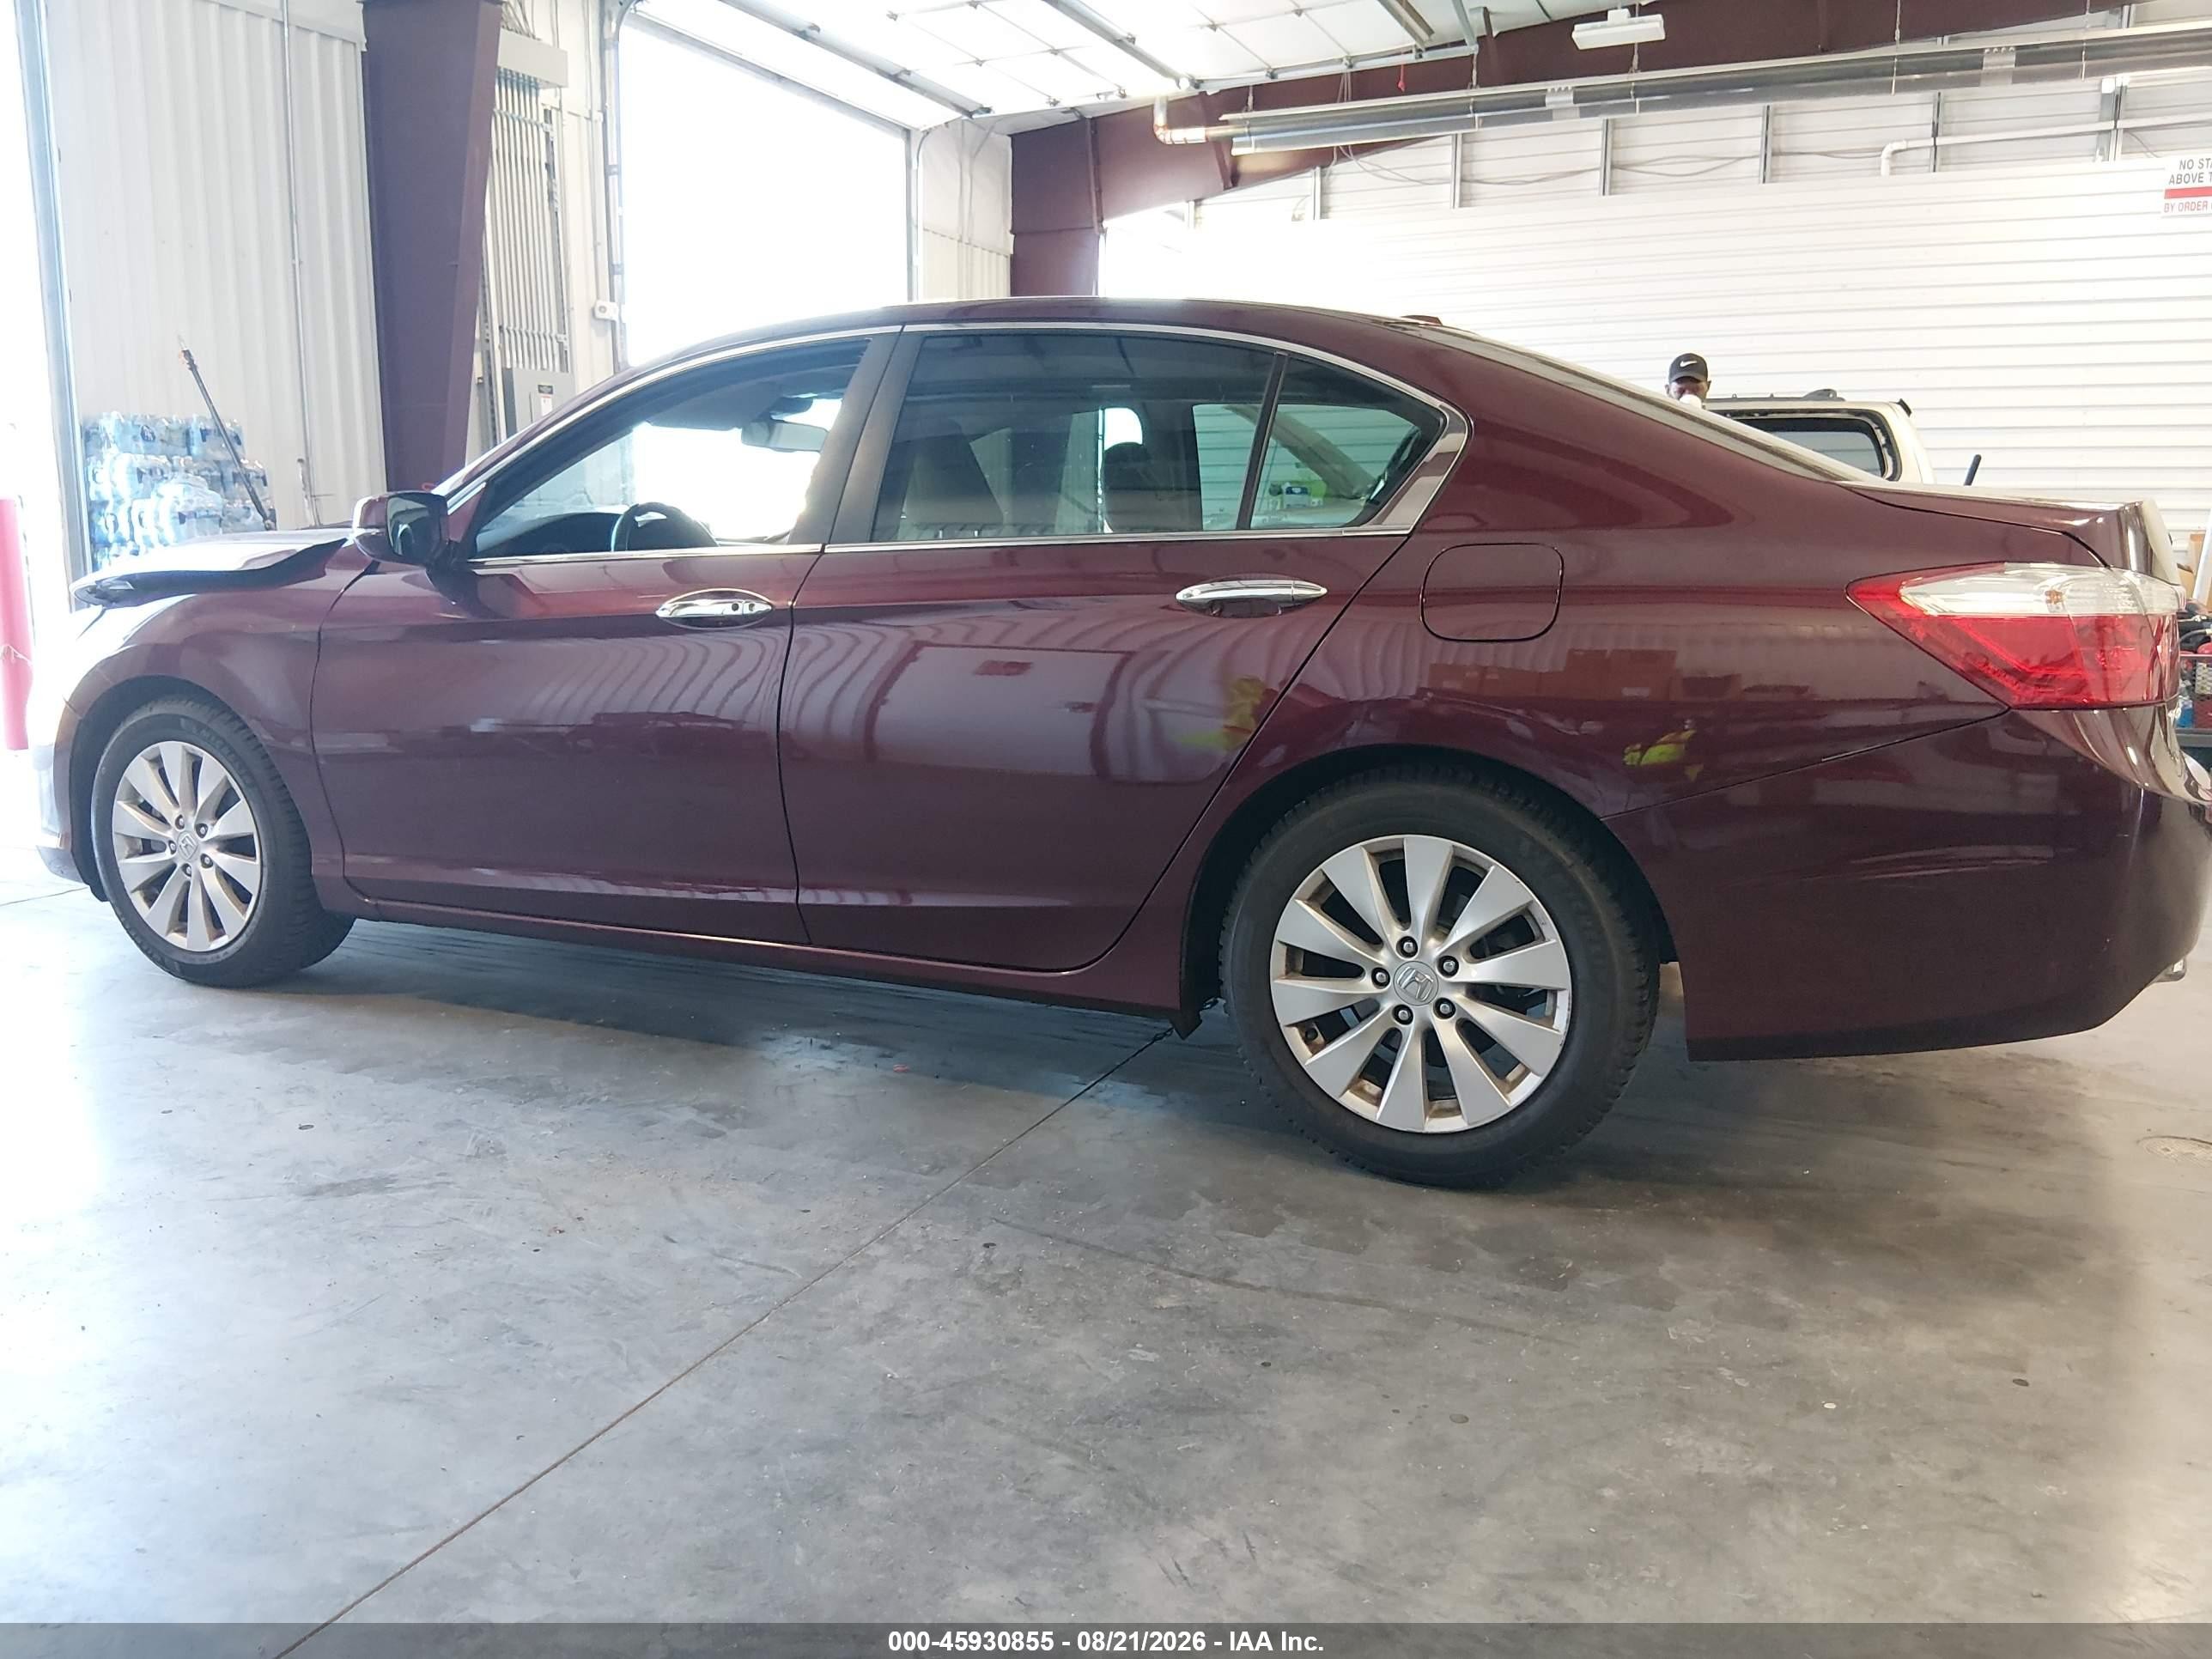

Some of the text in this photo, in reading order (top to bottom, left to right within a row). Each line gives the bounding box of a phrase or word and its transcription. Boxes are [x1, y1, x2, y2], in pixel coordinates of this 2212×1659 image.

[2179, 159, 2195, 170] NO
[2168, 172, 2204, 185] ABOVE
[2164, 203, 2175, 212] BY
[2178, 201, 2208, 212] ORDER
